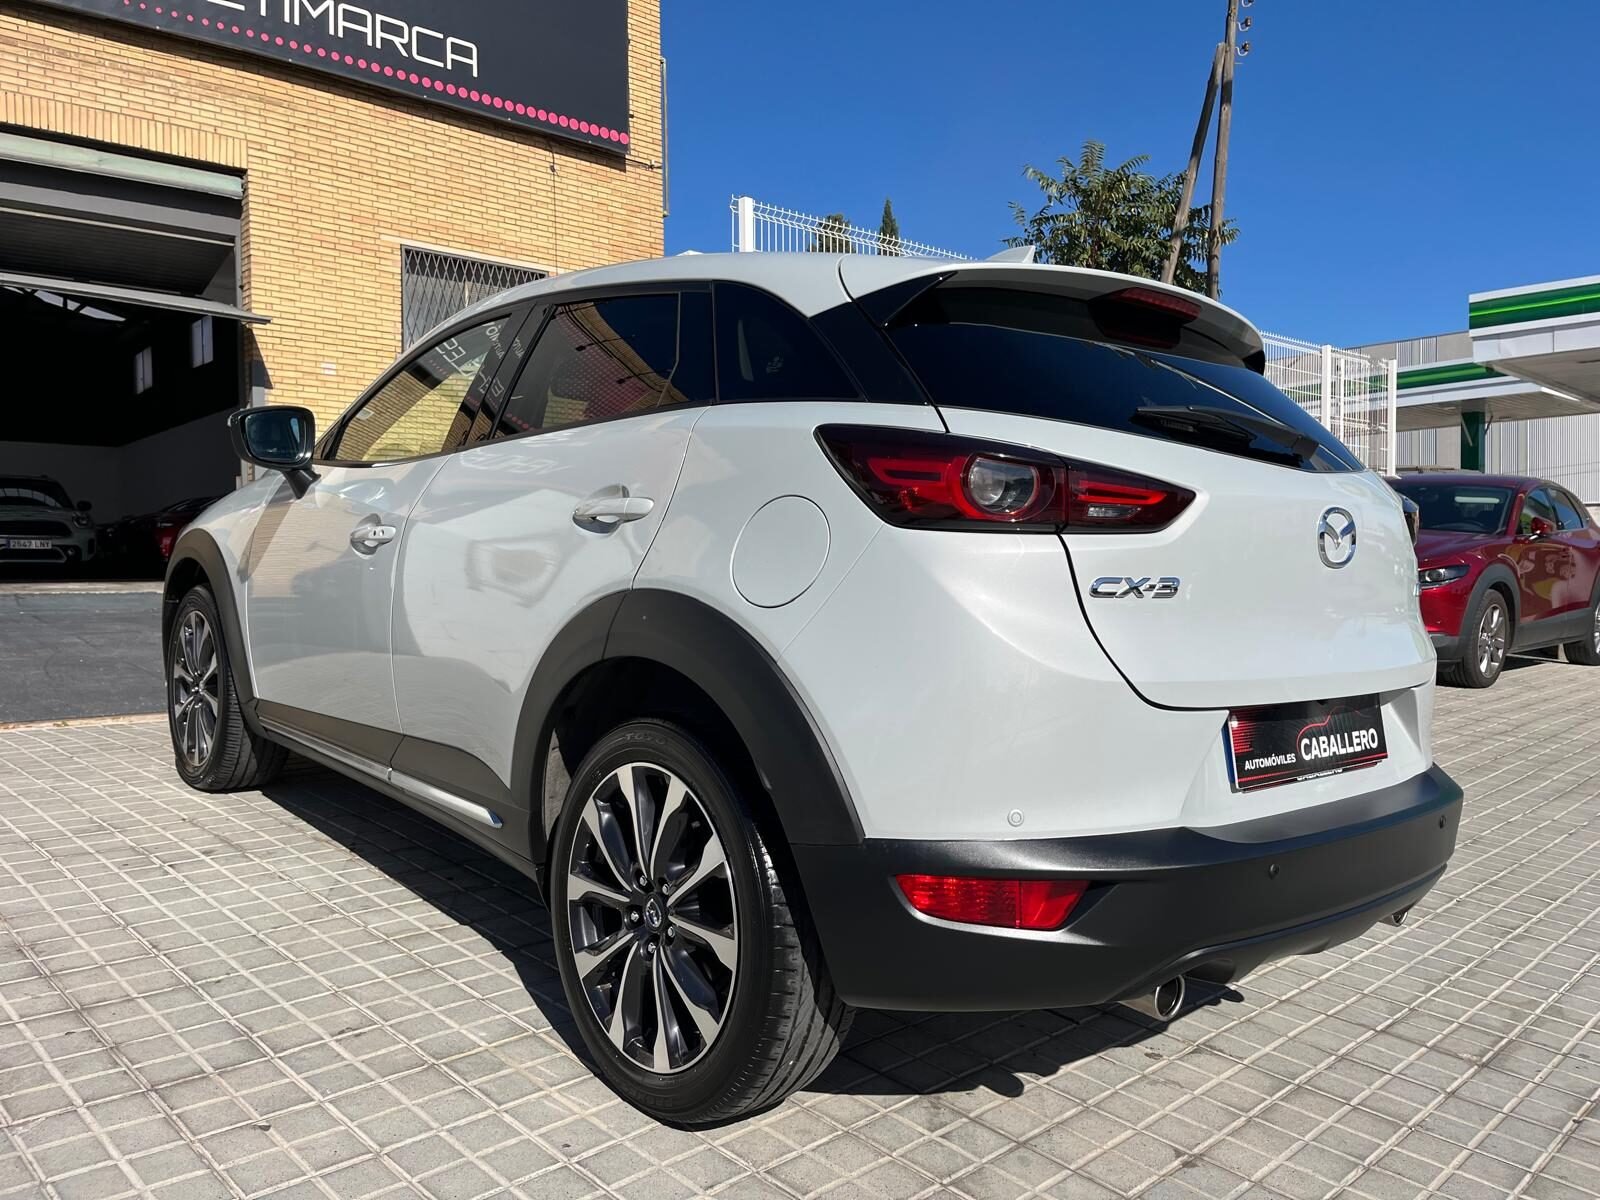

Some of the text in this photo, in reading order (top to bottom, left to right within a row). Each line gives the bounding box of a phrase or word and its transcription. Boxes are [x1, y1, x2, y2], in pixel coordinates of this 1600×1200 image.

[1089, 576, 1181, 599] CX-3
[1244, 728, 1378, 771] AUTOMÓVILES CABALLERO
